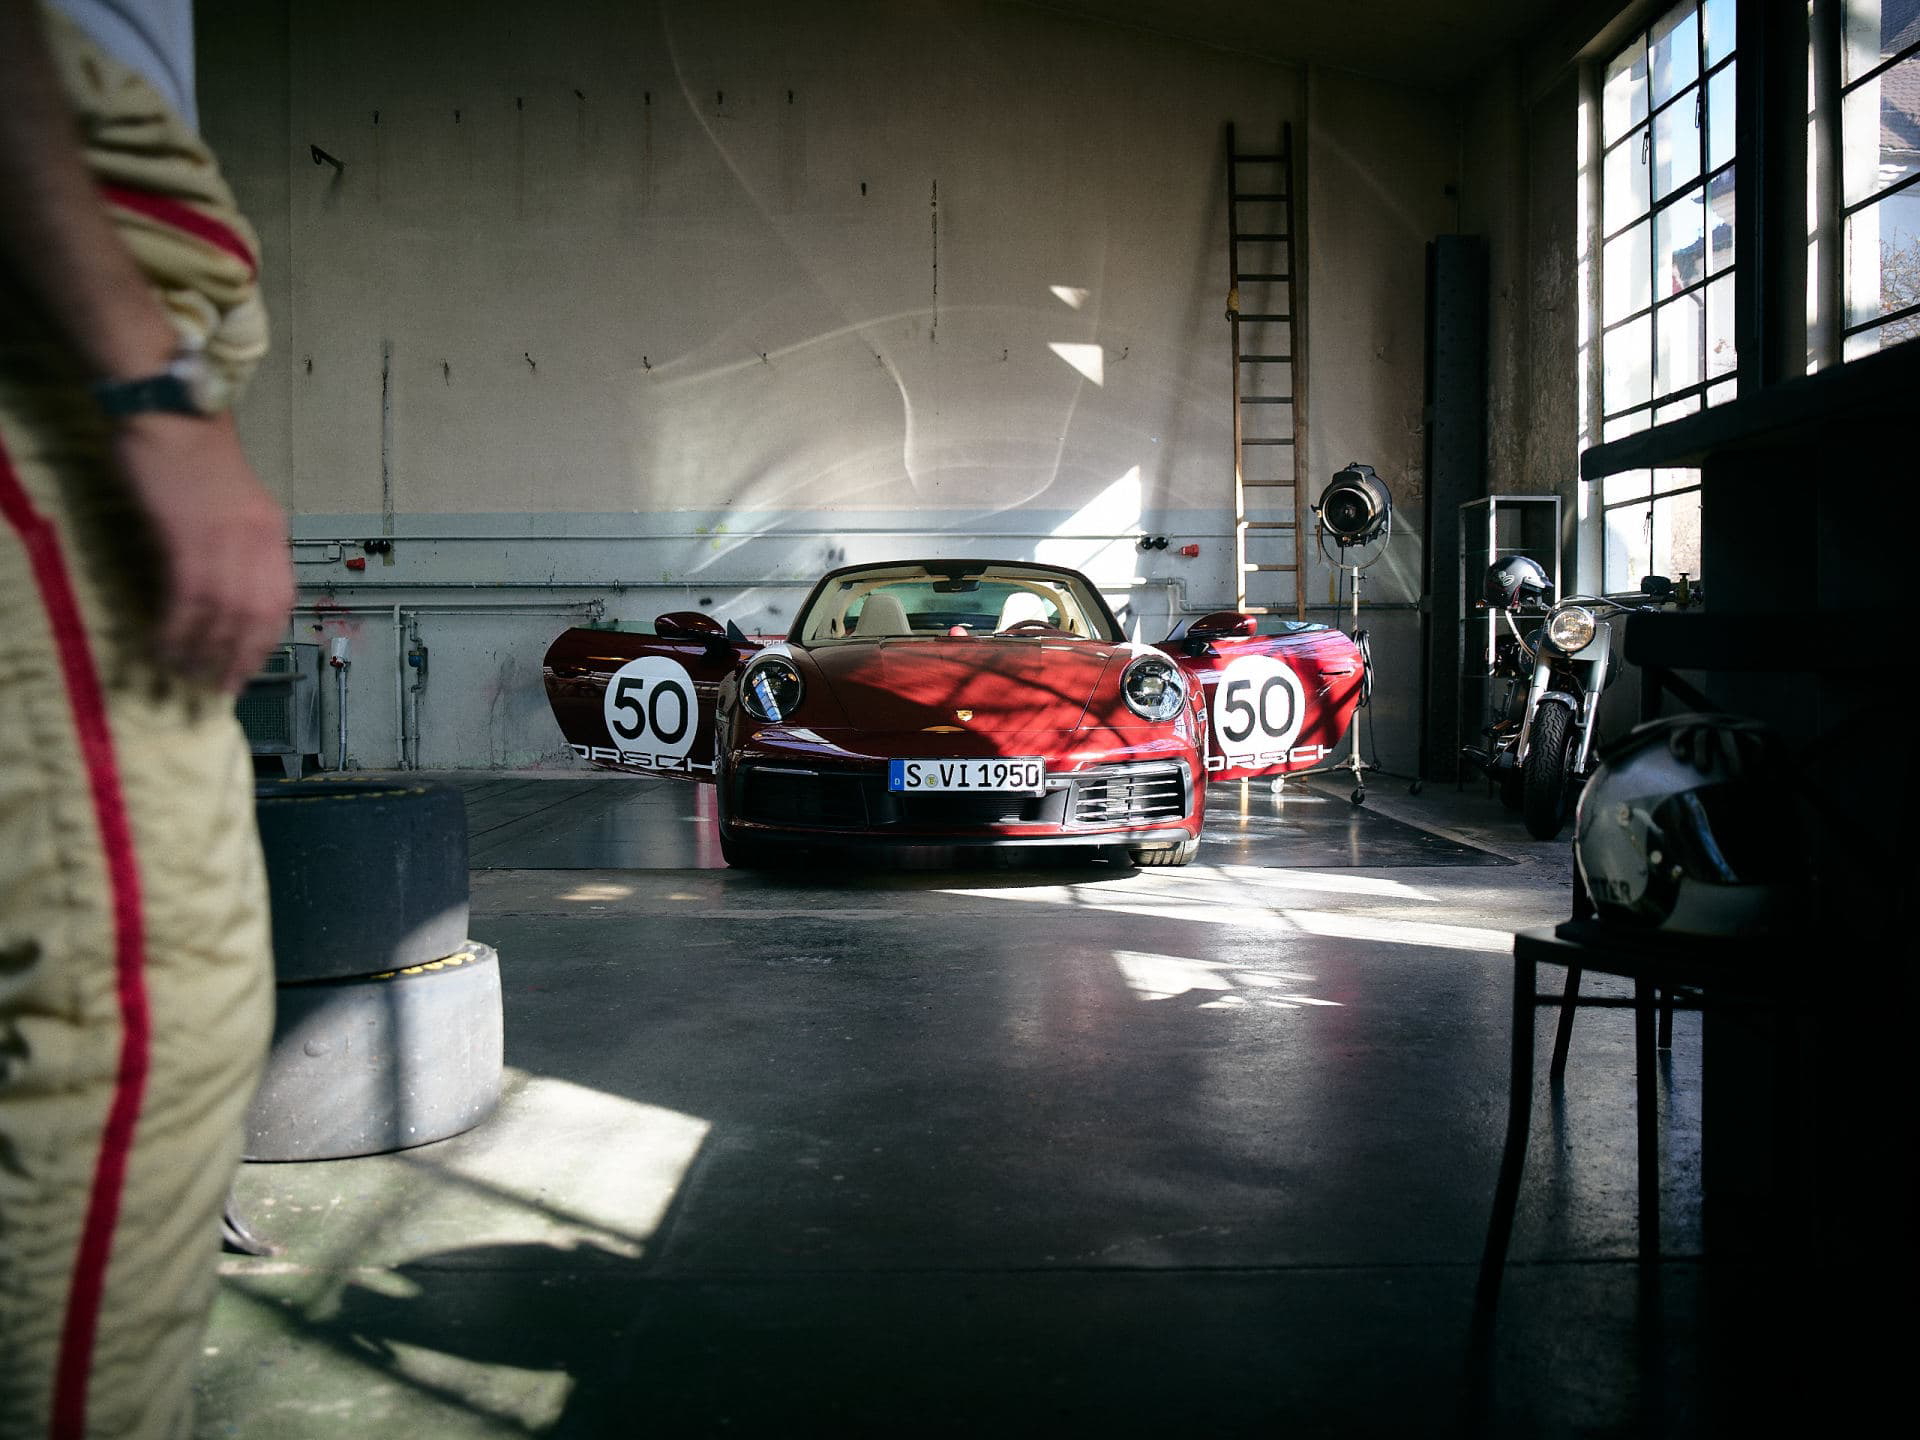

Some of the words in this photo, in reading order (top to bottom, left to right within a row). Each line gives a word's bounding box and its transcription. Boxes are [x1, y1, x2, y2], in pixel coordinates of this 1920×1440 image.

[613, 677, 688, 744] 50
[1223, 676, 1295, 743] 50
[906, 764, 922, 787] S
[939, 764, 970, 787] VI
[978, 764, 1039, 787] 1950
